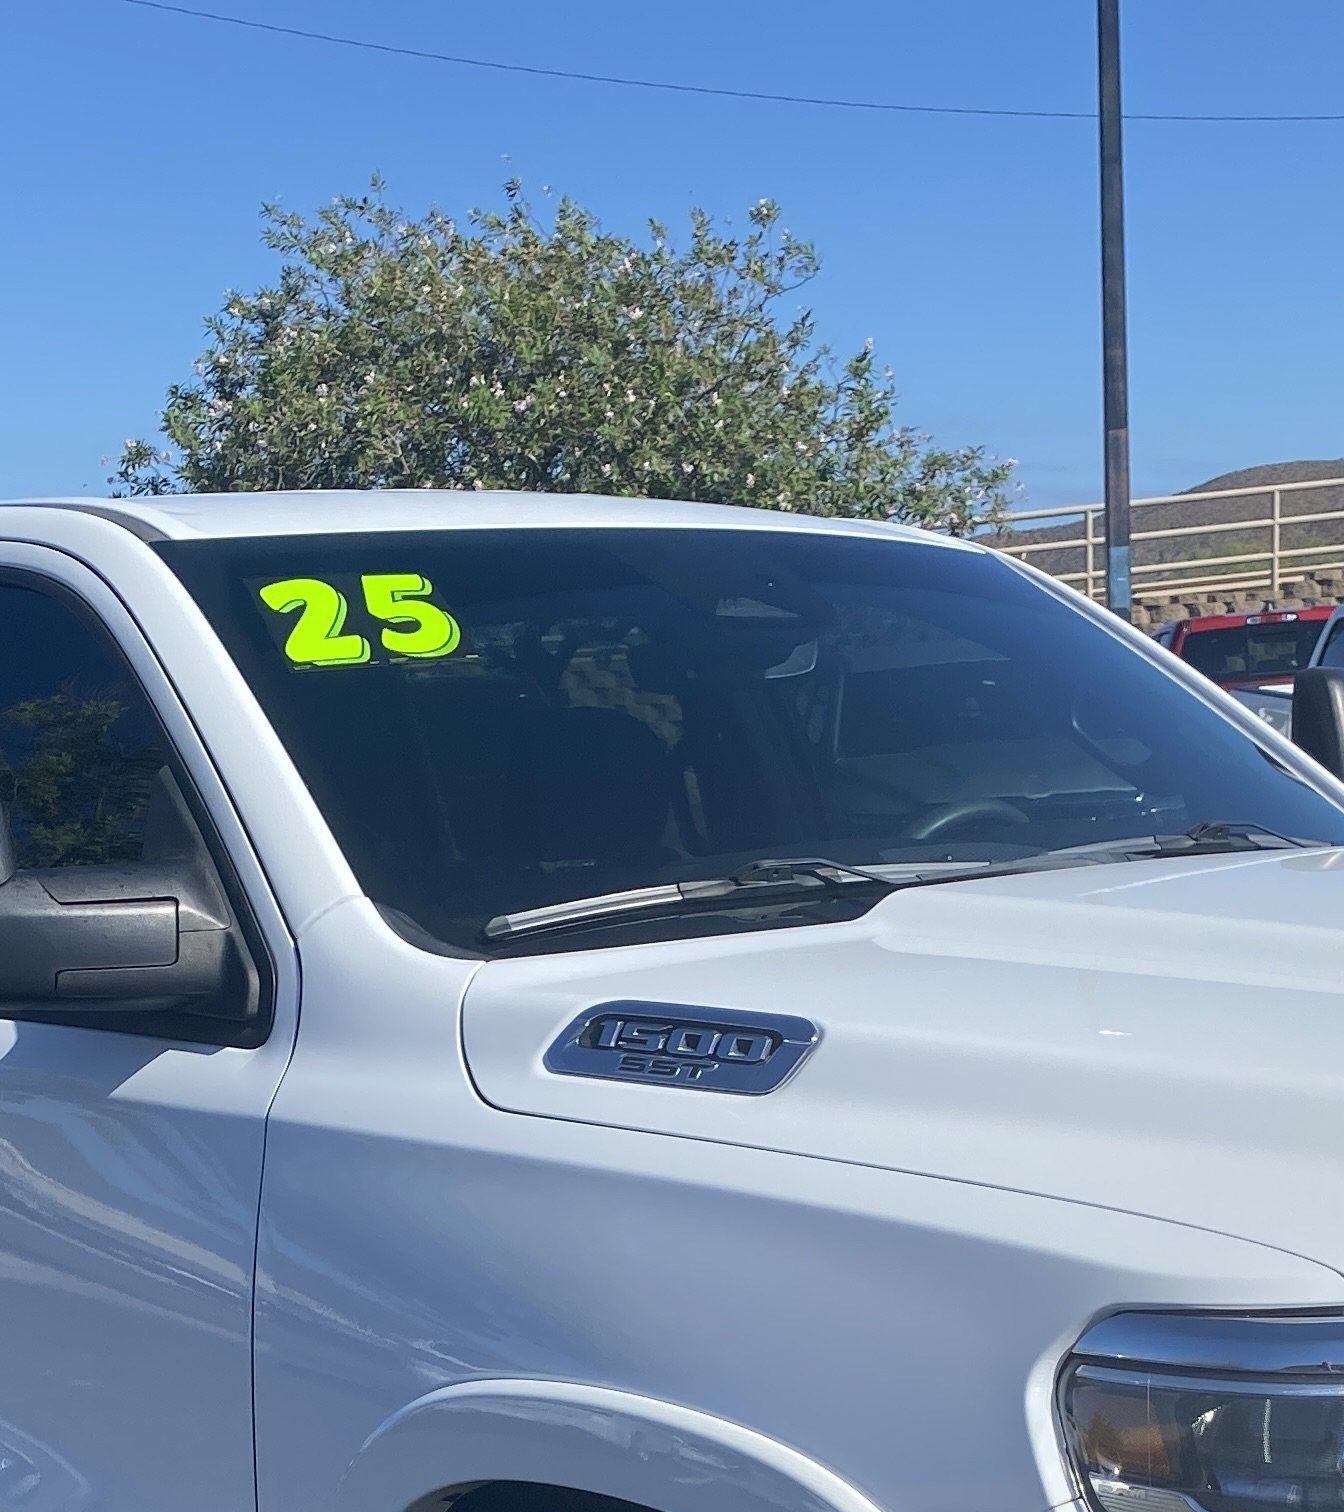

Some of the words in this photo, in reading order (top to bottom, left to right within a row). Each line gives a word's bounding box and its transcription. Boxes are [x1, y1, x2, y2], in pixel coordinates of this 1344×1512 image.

[259, 573, 461, 666] 25
[598, 1018, 773, 1062] 1500
[615, 1052, 720, 1081] SST
